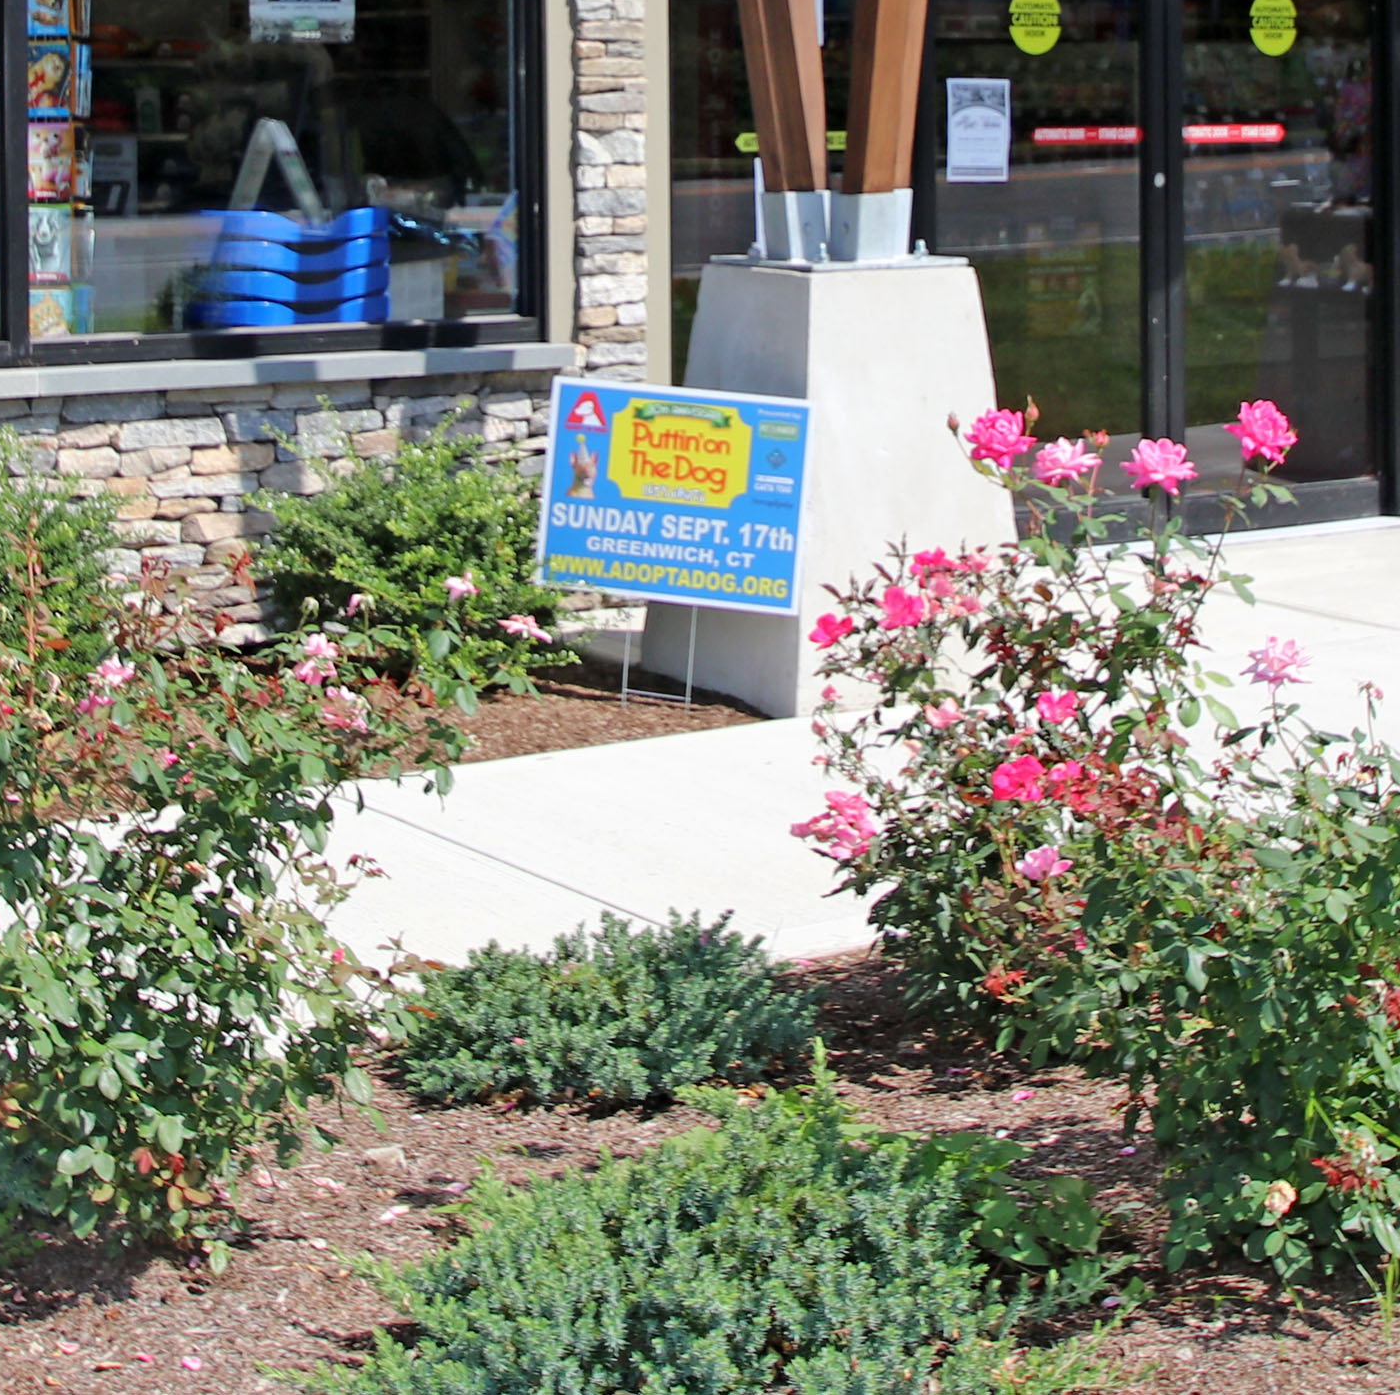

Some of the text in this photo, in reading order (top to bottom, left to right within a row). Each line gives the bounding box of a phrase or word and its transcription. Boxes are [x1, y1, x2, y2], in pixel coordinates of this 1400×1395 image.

[1011, 13, 1059, 26] CAUTION
[1252, 16, 1295, 29] CAUTION
[703, 438, 731, 455] on
[628, 449, 672, 478] The
[674, 454, 727, 494] Dog
[551, 502, 794, 552] SUNDAY SEPT. 17th
[586, 535, 756, 568] GREENWICH, CT
[549, 553, 788, 598] WWW.ADOPTADOG.ORG
